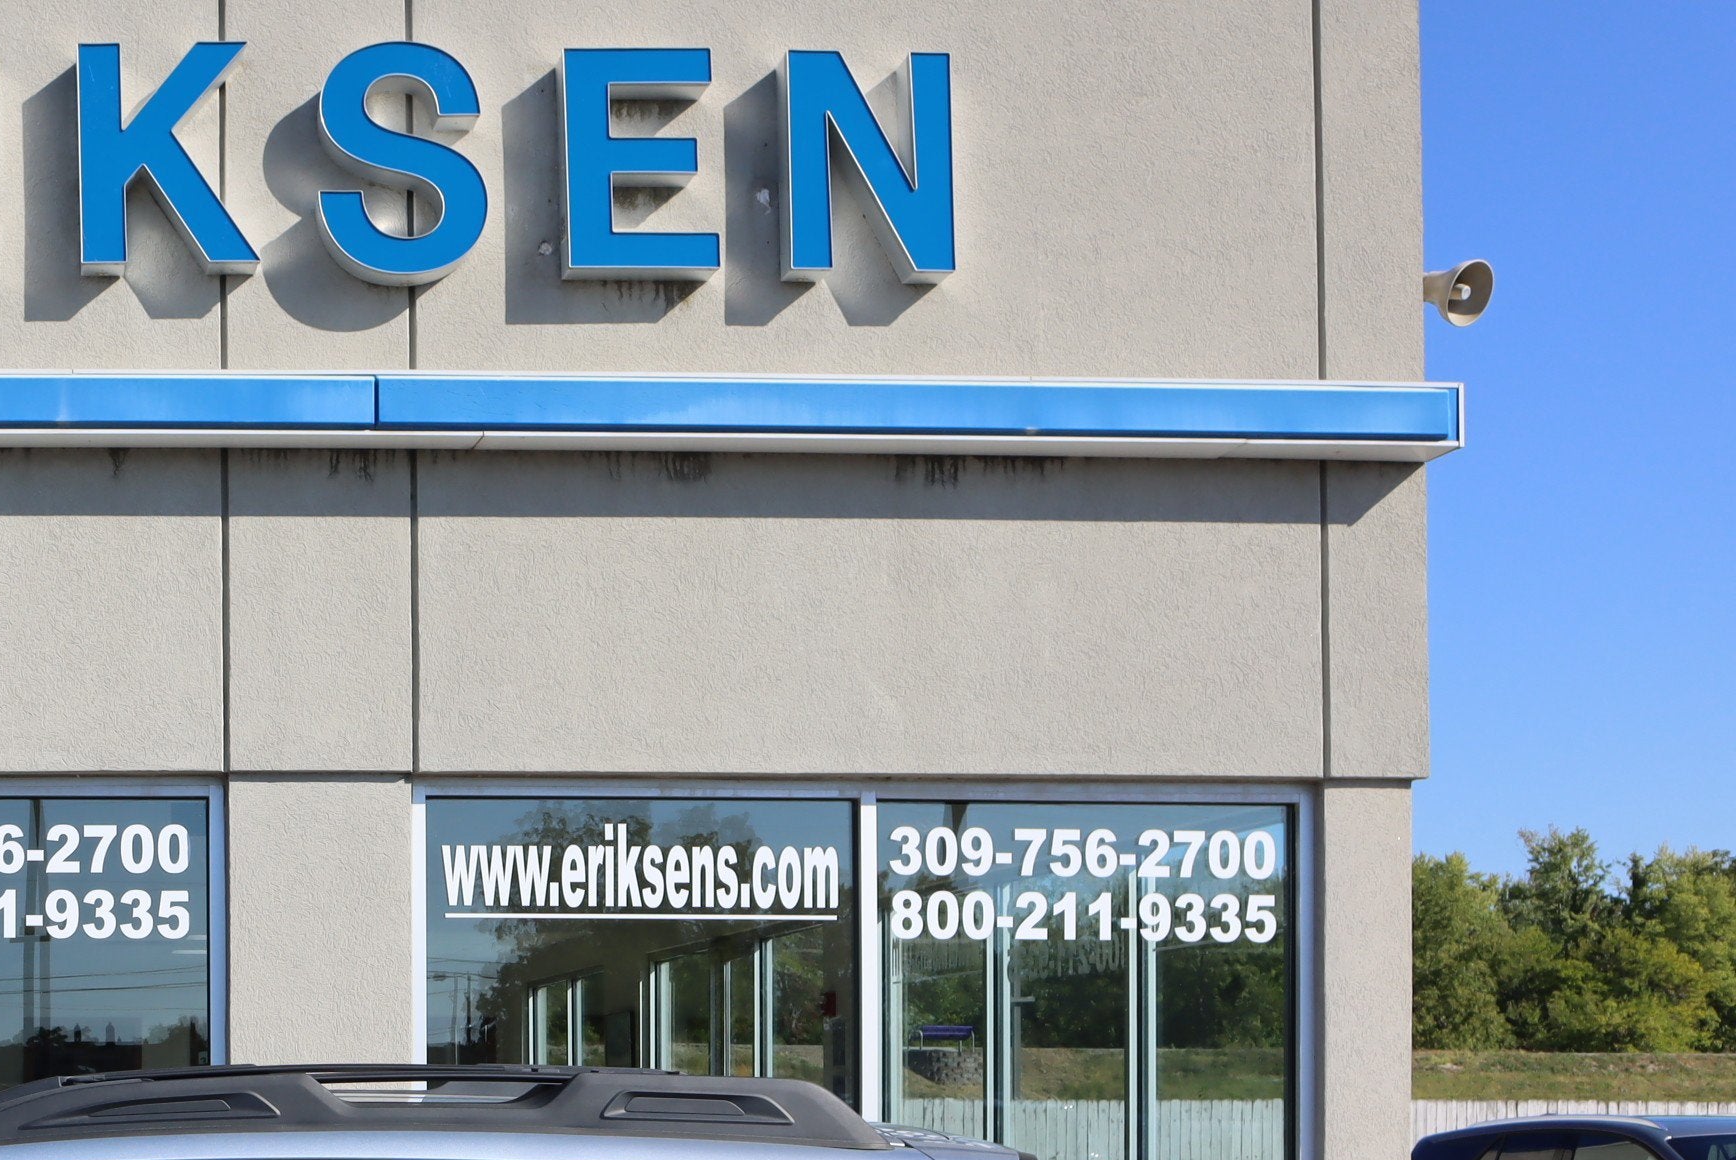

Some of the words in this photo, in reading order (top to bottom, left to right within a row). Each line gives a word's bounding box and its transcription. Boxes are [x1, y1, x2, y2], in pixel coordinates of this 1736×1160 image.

[441, 823, 839, 909] www.eriksens.com
[889, 826, 1276, 880] 309-756-2700
[890, 890, 1277, 943] 800-211-9335
